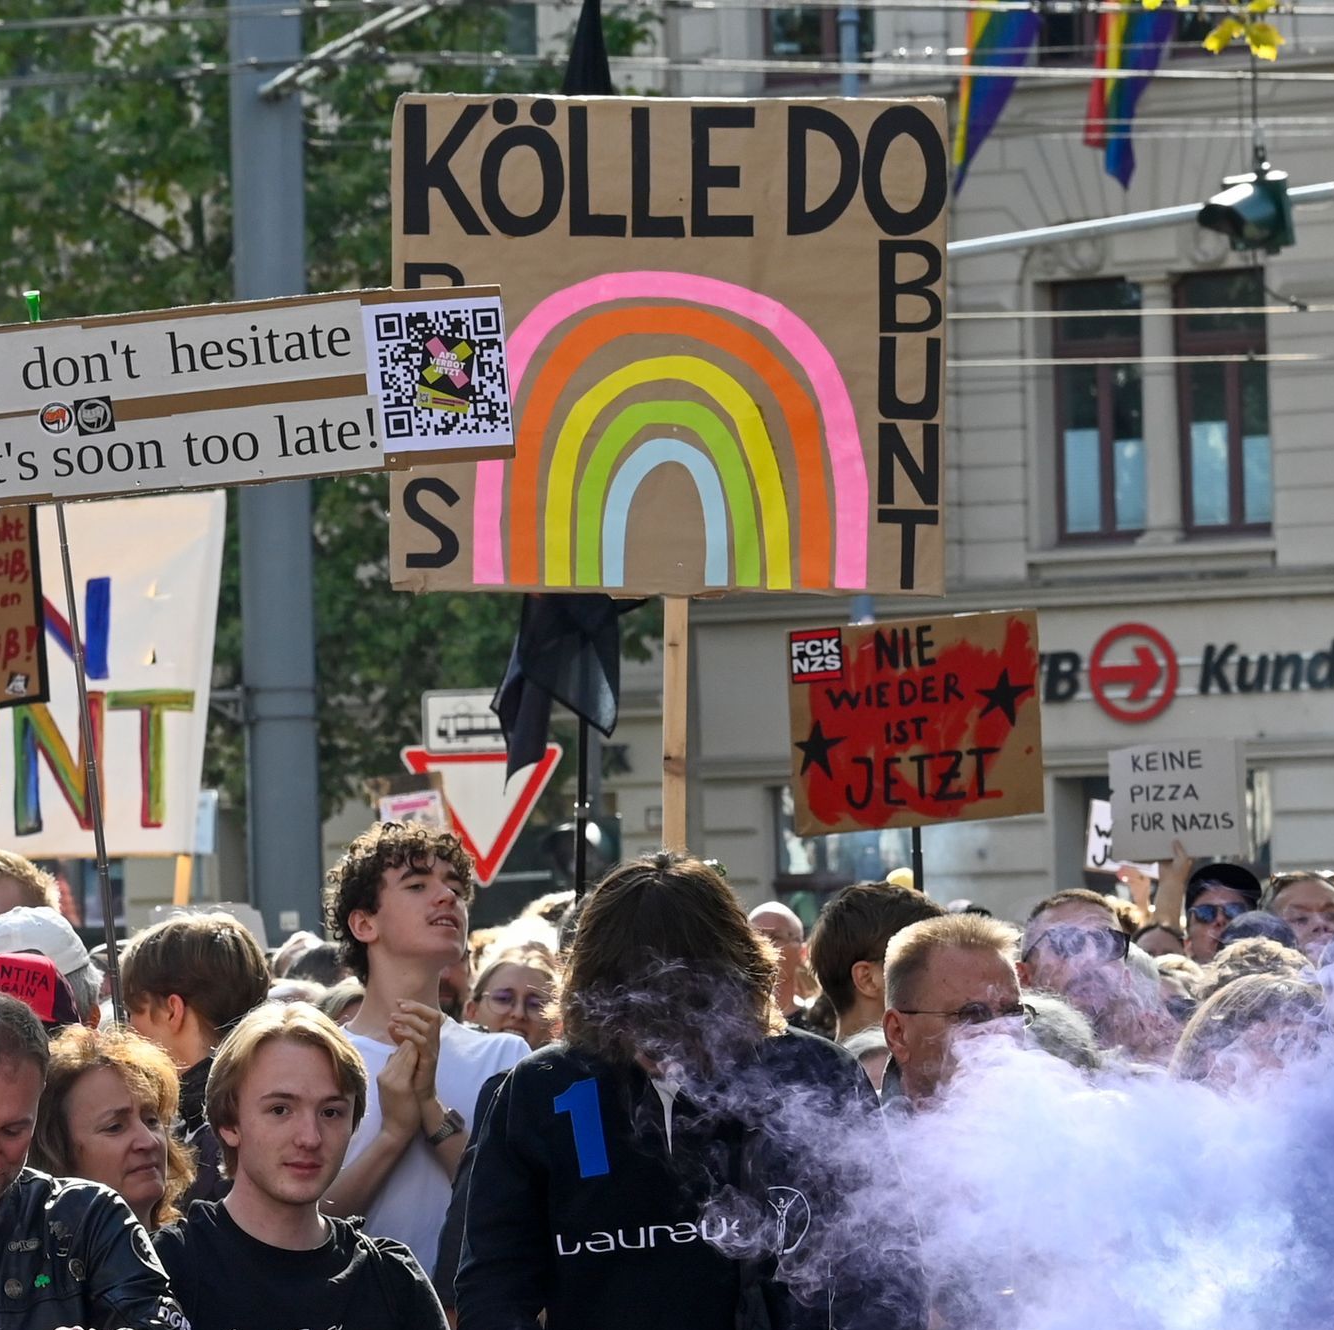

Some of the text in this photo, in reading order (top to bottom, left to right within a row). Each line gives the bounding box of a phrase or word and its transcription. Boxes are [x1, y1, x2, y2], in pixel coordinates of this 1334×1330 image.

[403, 98, 947, 238] KÖLLE DO
[22, 340, 141, 390] don't
[166, 323, 352, 376] hesitate
[429, 357, 466, 370] VERBOT
[438, 351, 458, 361] AFD
[433, 366, 461, 377] JETZT
[877, 240, 943, 590] BUNT
[52, 434, 167, 478] soon
[182, 428, 260, 467] too
[274, 407, 378, 458] late!
[791, 637, 840, 659] FCK
[874, 624, 937, 672] NIE
[791, 655, 842, 675] NZS
[825, 672, 965, 711] WIEDER
[884, 716, 929, 746] IST
[1130, 750, 1203, 773] KEINE
[845, 747, 1002, 811] JETZT
[1129, 783, 1200, 804] PIZZA
[1171, 812, 1235, 833] NAZIS
[553, 1077, 610, 1179] 1
